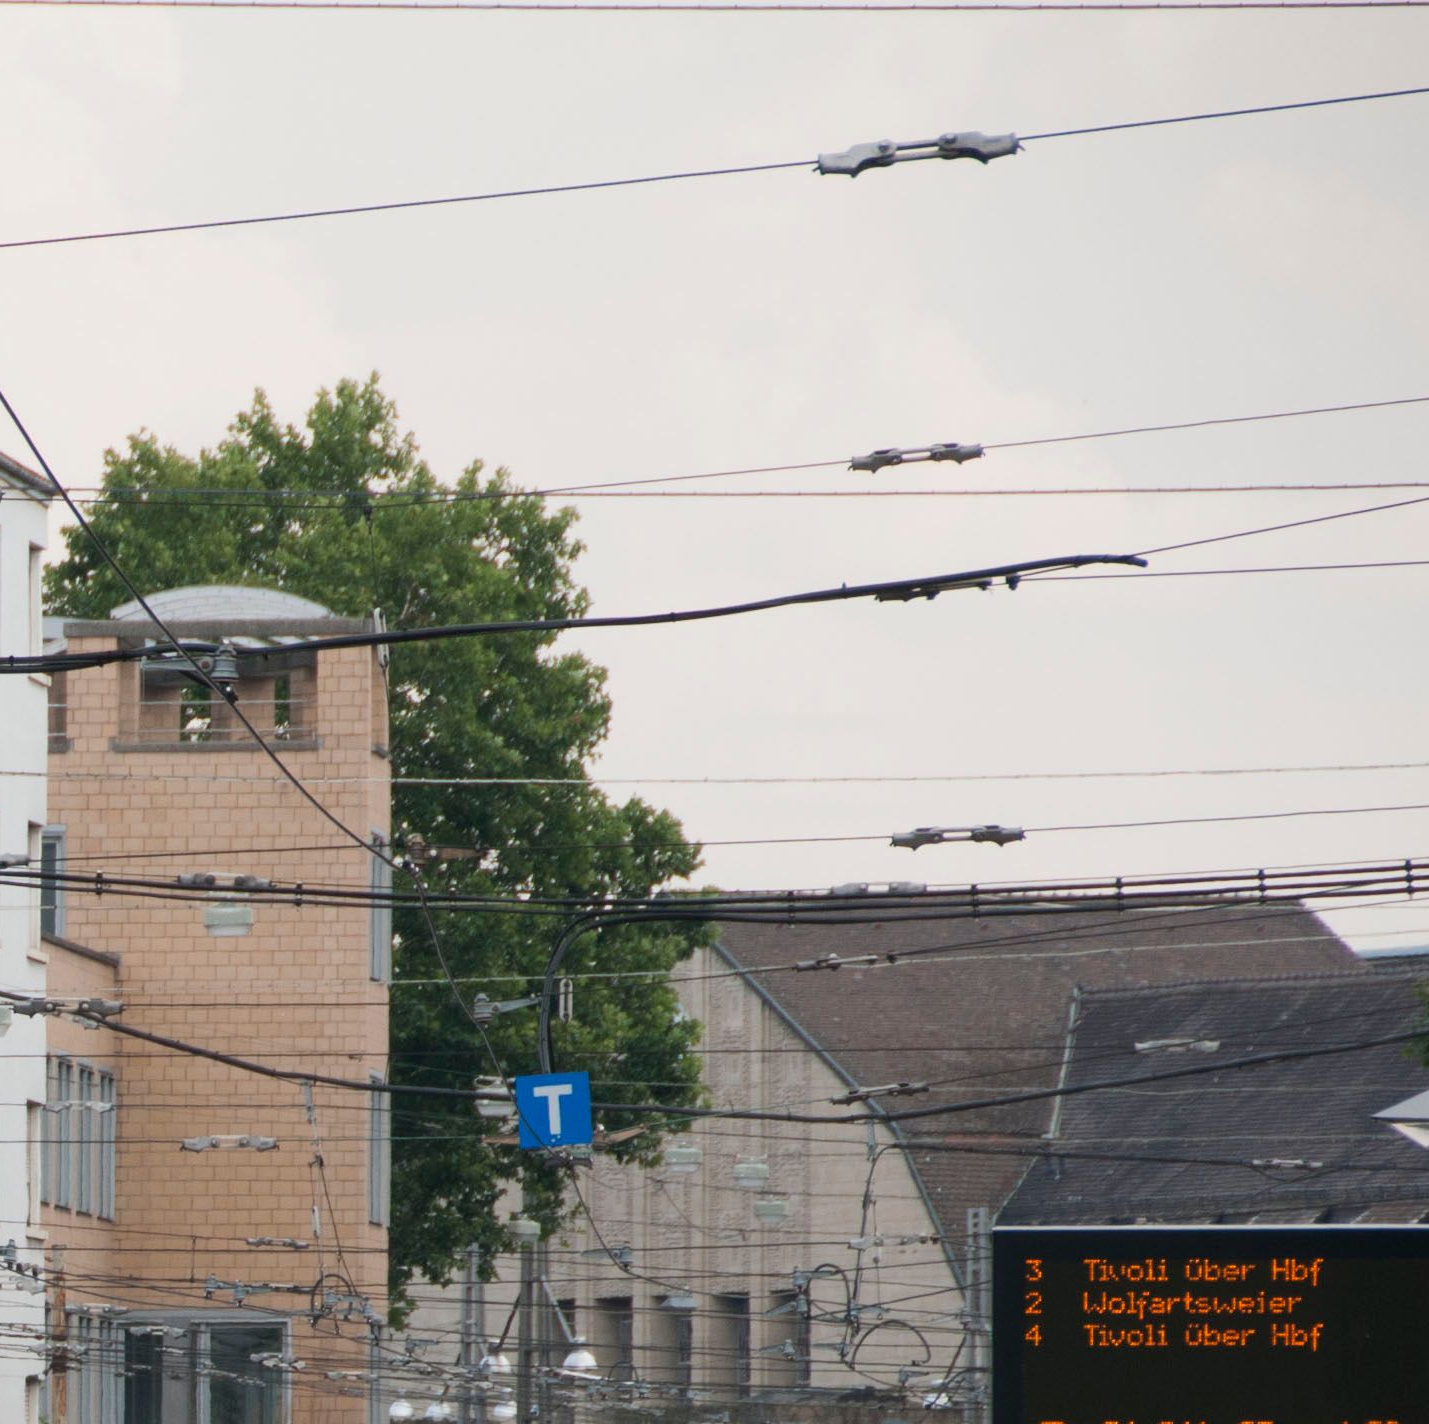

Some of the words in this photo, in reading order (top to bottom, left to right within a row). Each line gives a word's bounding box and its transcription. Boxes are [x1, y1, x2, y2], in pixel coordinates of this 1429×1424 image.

[533, 1084, 572, 1135] T
[1025, 1258, 1043, 1282] 3
[1083, 1258, 1169, 1282] Tivoli
[1184, 1258, 1256, 1281] über
[1271, 1257, 1324, 1287] Hbf
[1025, 1291, 1043, 1315] 2
[1082, 1290, 1302, 1320] Wolfartsweier
[1025, 1324, 1043, 1346] 4
[1083, 1324, 1168, 1346] Tivoli
[1184, 1323, 1256, 1346] über
[1271, 1322, 1324, 1352] Hbf
